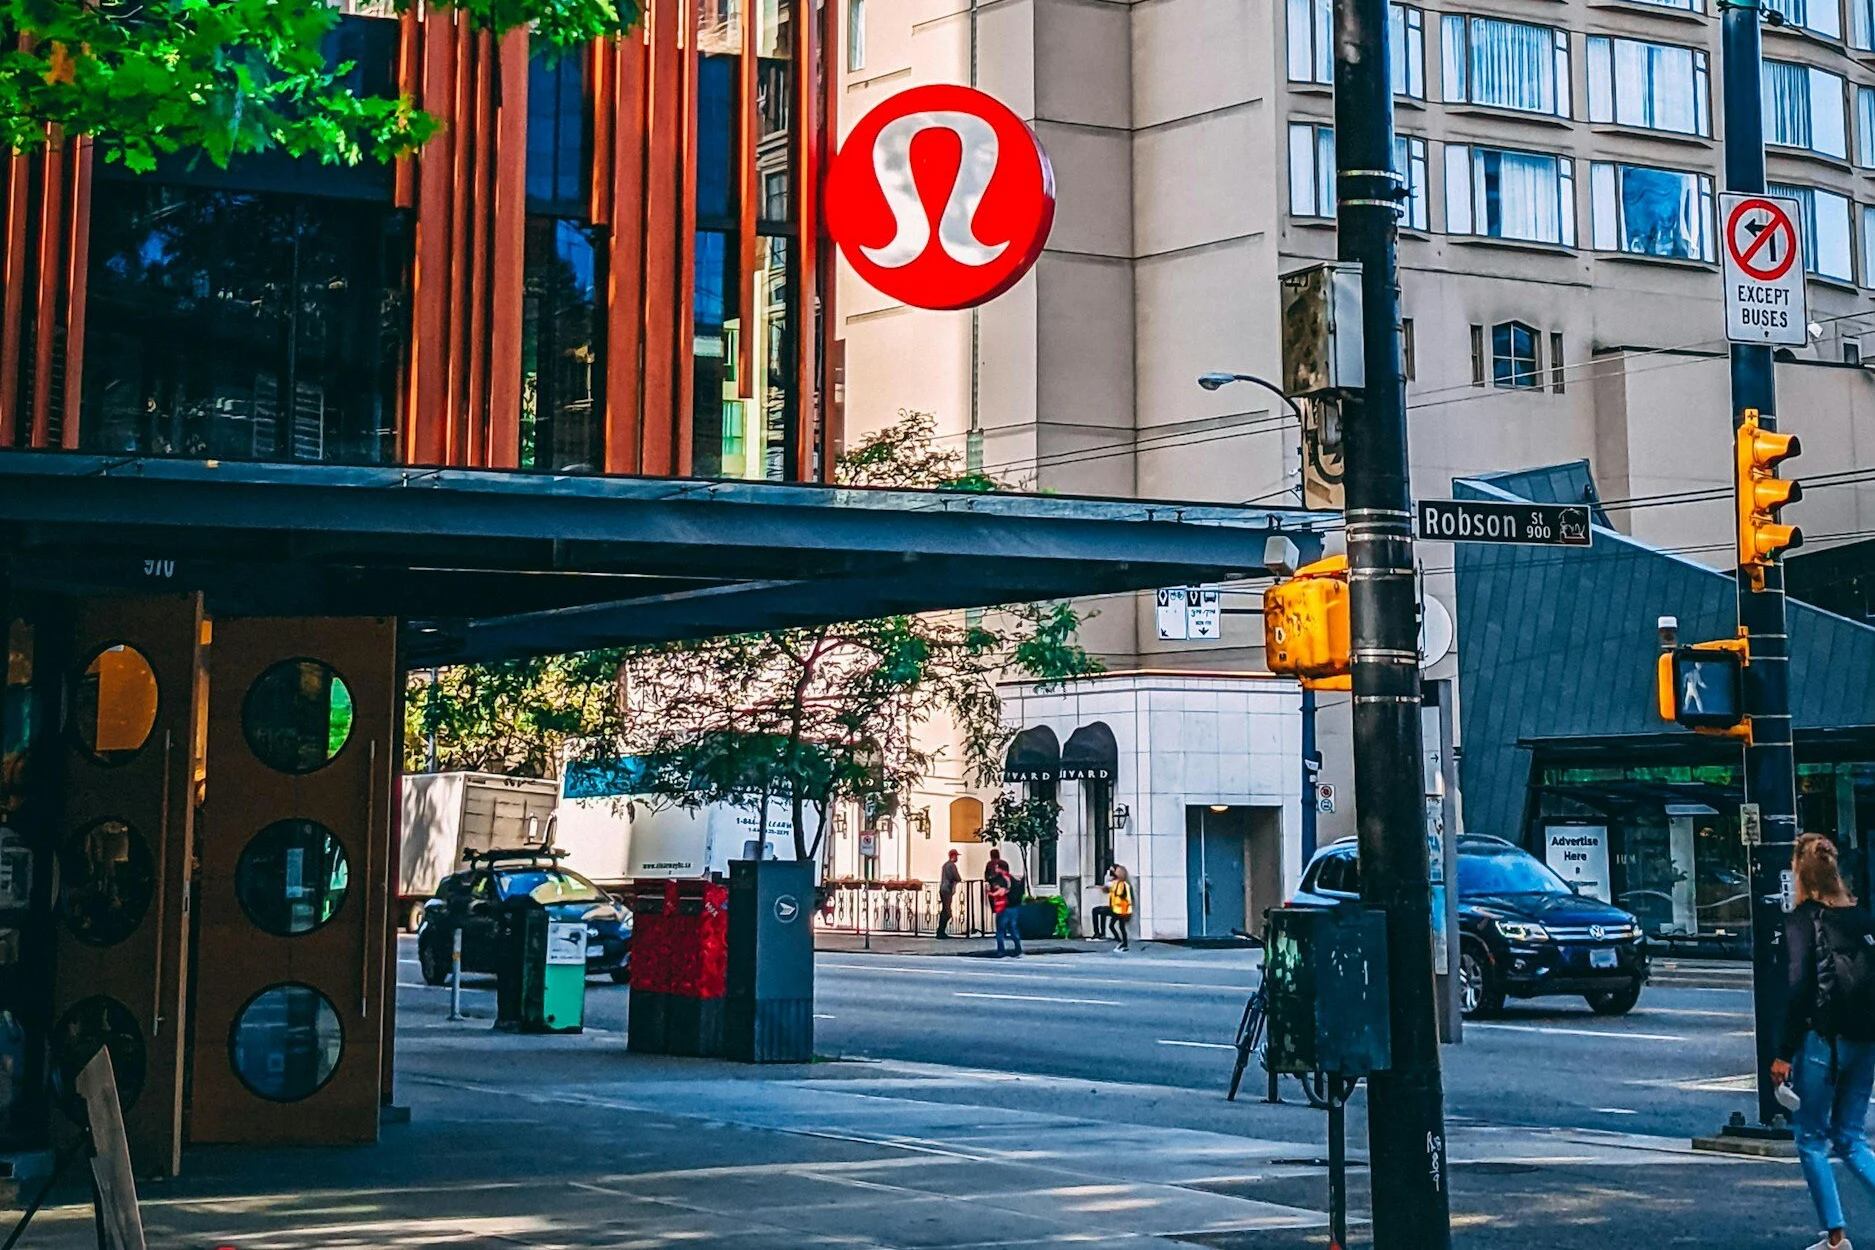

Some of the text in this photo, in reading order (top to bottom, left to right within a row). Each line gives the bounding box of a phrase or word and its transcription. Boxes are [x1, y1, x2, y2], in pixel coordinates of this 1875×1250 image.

[1738, 285, 1790, 306] EXCEPT
[1742, 308, 1788, 328] BUSES
[1425, 507, 1543, 538] Robson St
[1526, 526, 1551, 539] 900
[1551, 836, 1599, 847] Advertise
[1564, 851, 1587, 861] Here
